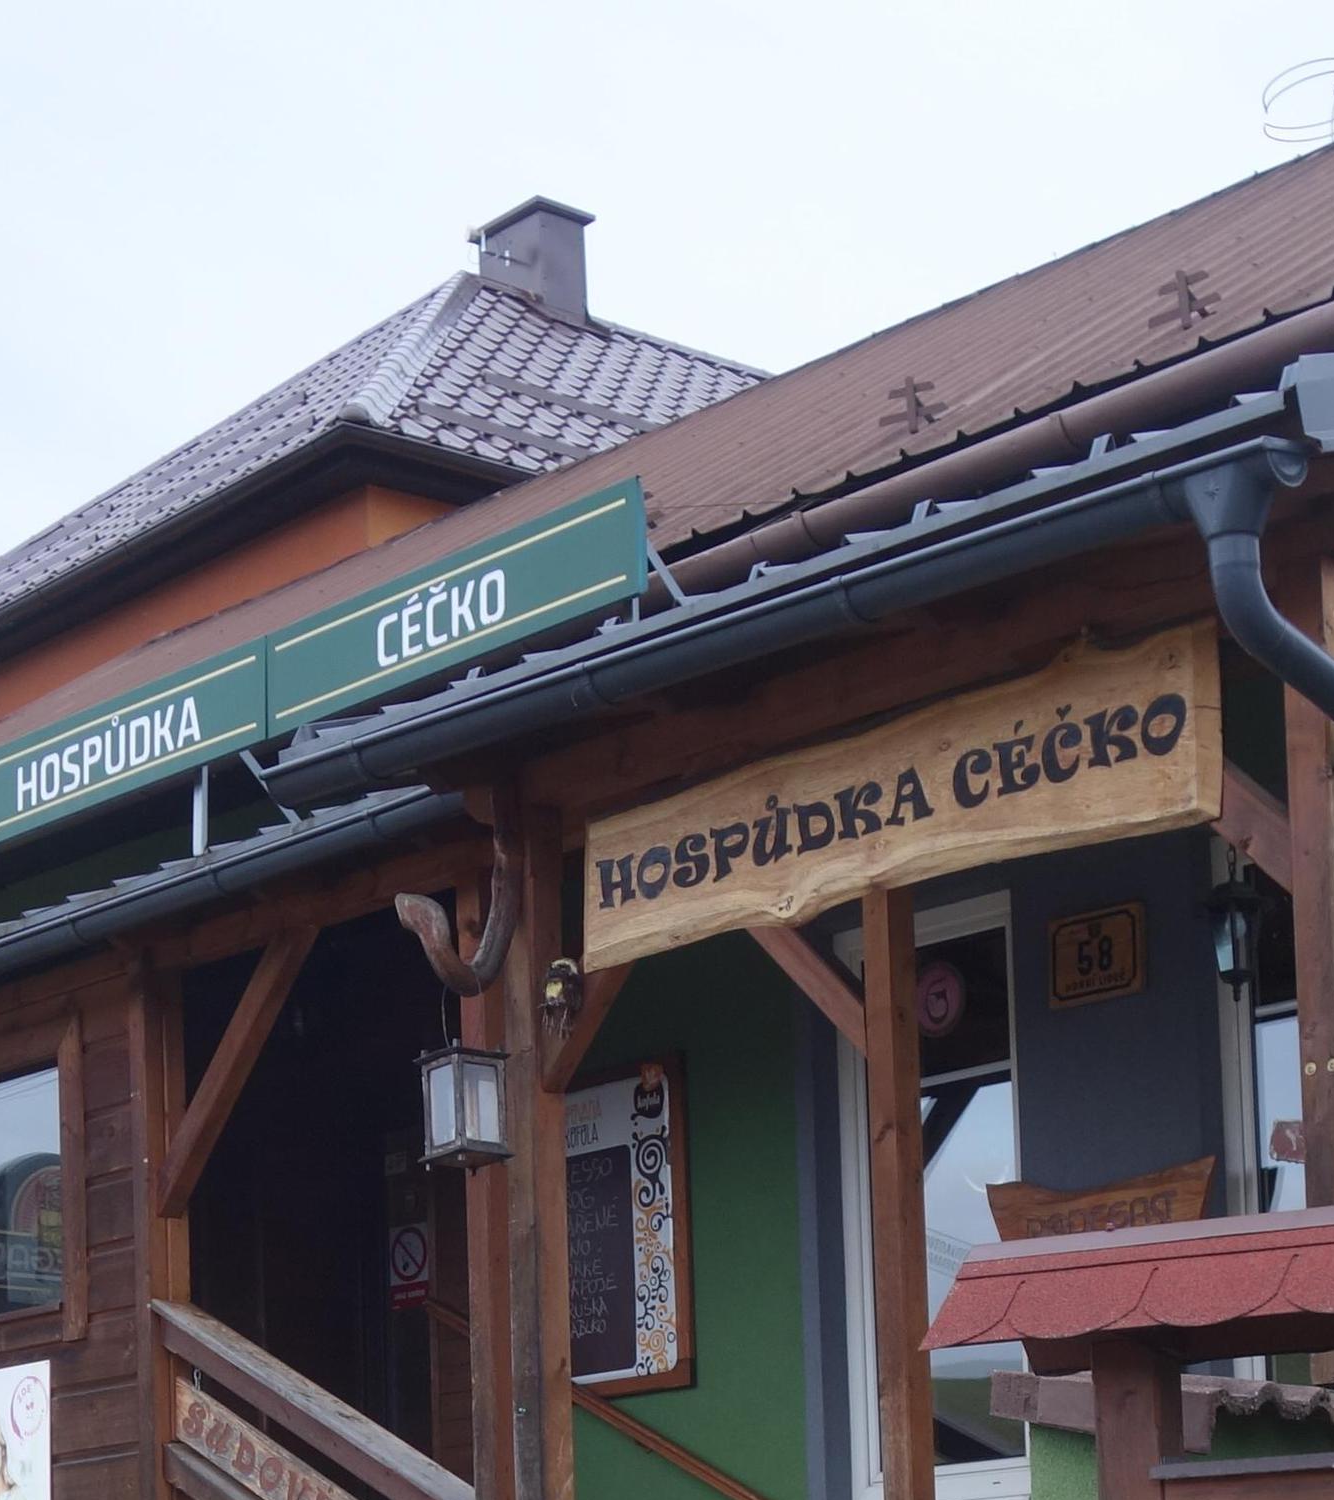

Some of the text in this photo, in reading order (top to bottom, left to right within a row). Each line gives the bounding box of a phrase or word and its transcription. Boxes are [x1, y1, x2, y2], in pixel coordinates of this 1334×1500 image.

[15, 569, 507, 812] HOSPŮDKA CÉČKO
[595, 692, 1188, 909] HOSPŮDKA CÉČKO
[1076, 935, 1113, 977] 58
[569, 1157, 613, 1184] ESSO
